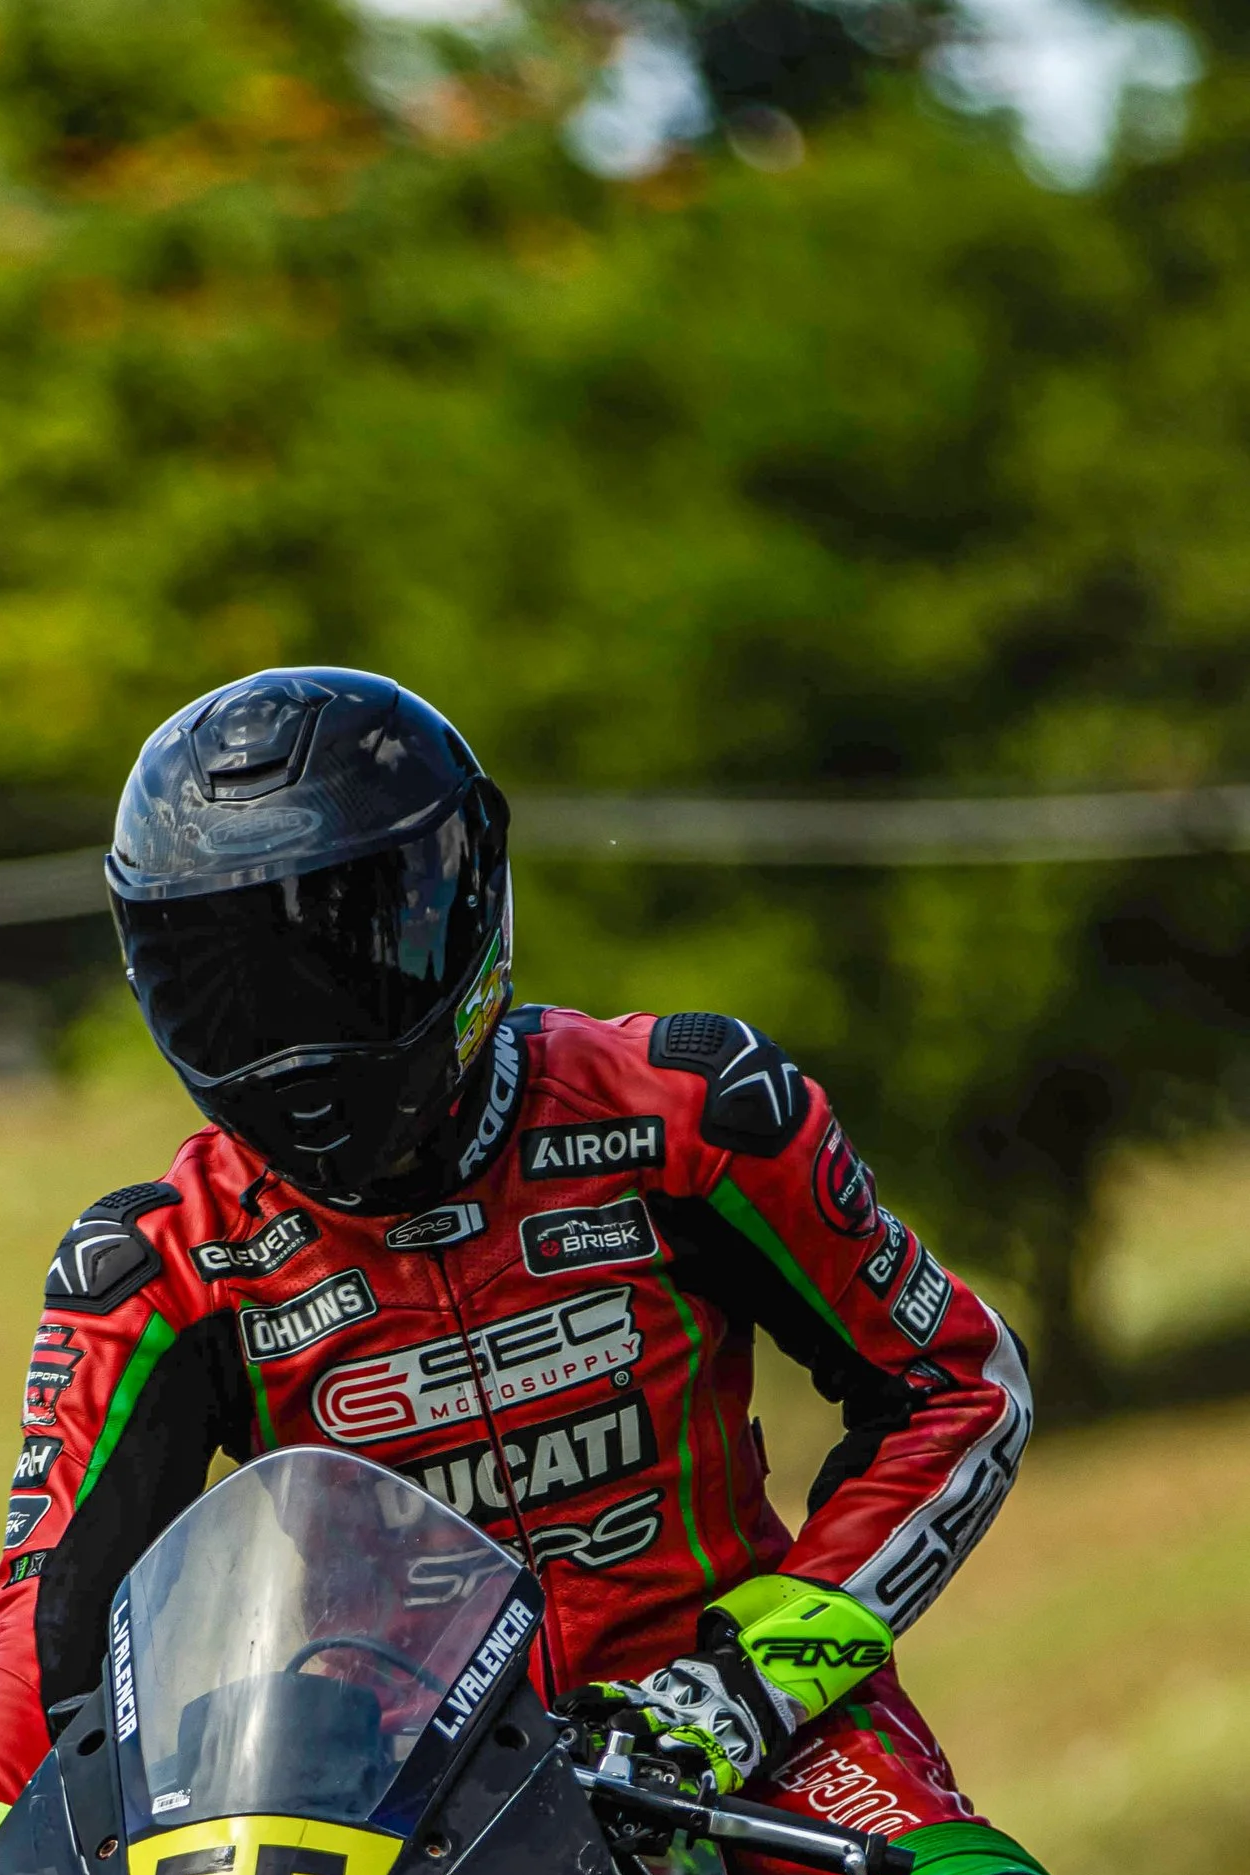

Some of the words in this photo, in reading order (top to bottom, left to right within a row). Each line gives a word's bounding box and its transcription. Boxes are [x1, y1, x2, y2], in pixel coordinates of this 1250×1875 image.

[532, 1126, 656, 1170] AIROH
[396, 1216, 452, 1244] SPPS
[562, 1226, 640, 1253] BRISK
[254, 1284, 364, 1350] ÖHLINS
[419, 1291, 626, 1395] SEC
[375, 1404, 641, 1529] DUCATI
[432, 1598, 535, 1741] L.VALENCIA
[752, 1637, 886, 1668] FIVE
